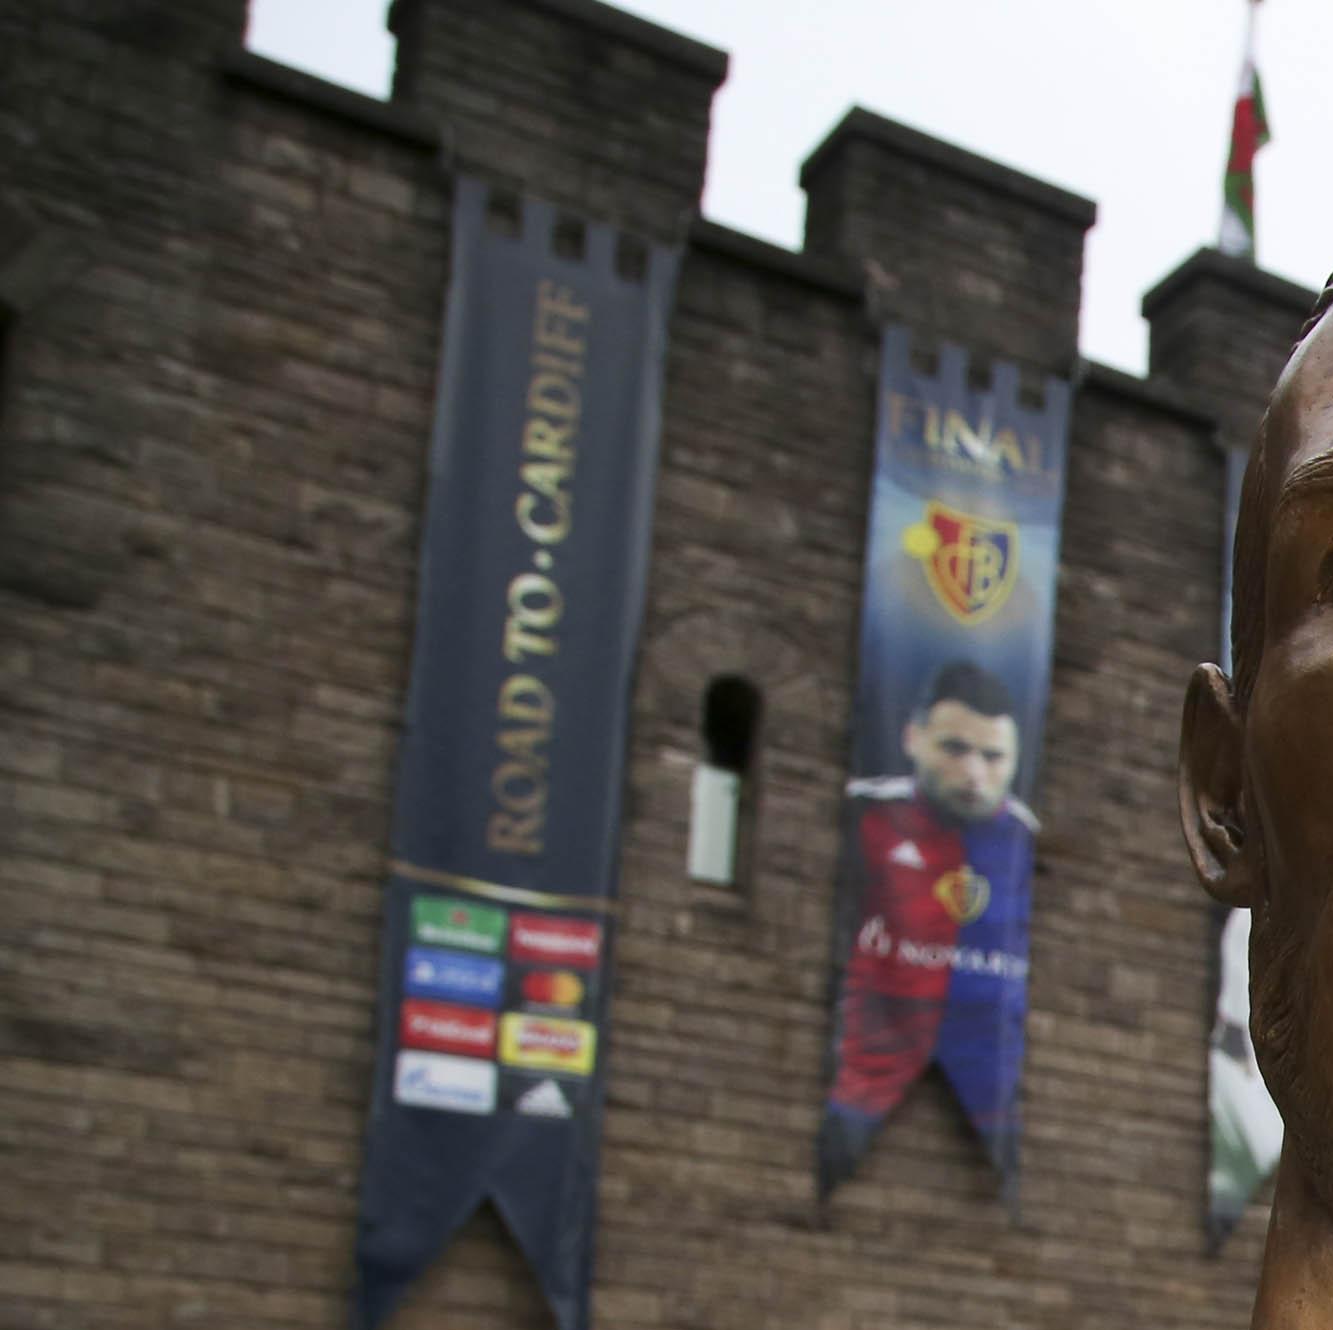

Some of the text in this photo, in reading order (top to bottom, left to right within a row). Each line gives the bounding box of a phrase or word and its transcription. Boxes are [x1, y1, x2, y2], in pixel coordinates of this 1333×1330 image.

[485, 277, 592, 857] ROAD TO CARDIFF
